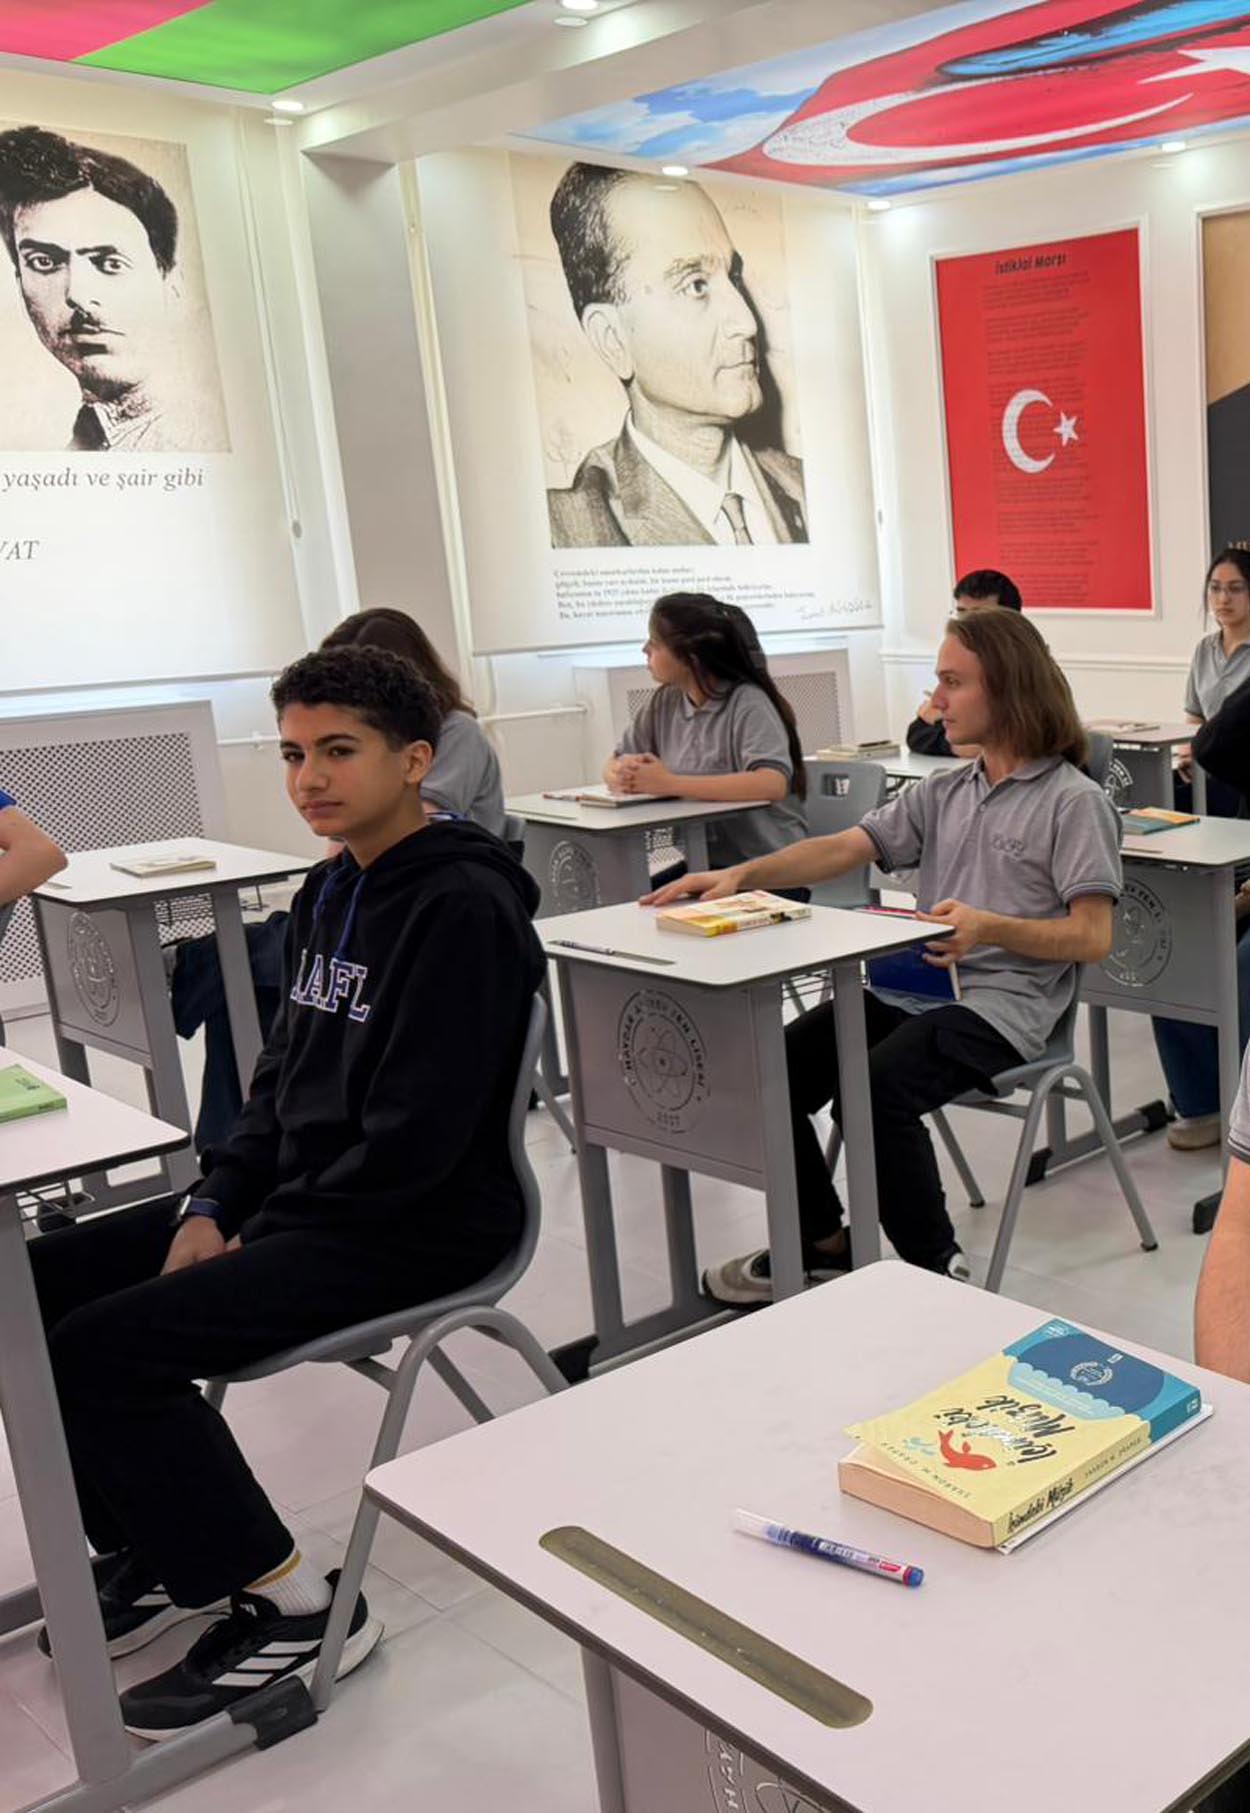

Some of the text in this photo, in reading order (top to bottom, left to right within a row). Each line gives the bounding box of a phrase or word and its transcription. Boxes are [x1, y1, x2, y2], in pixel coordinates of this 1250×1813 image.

[2, 467, 205, 493] yaşadı ve şair gibi
[975, 1394, 1077, 1440] Müzik
